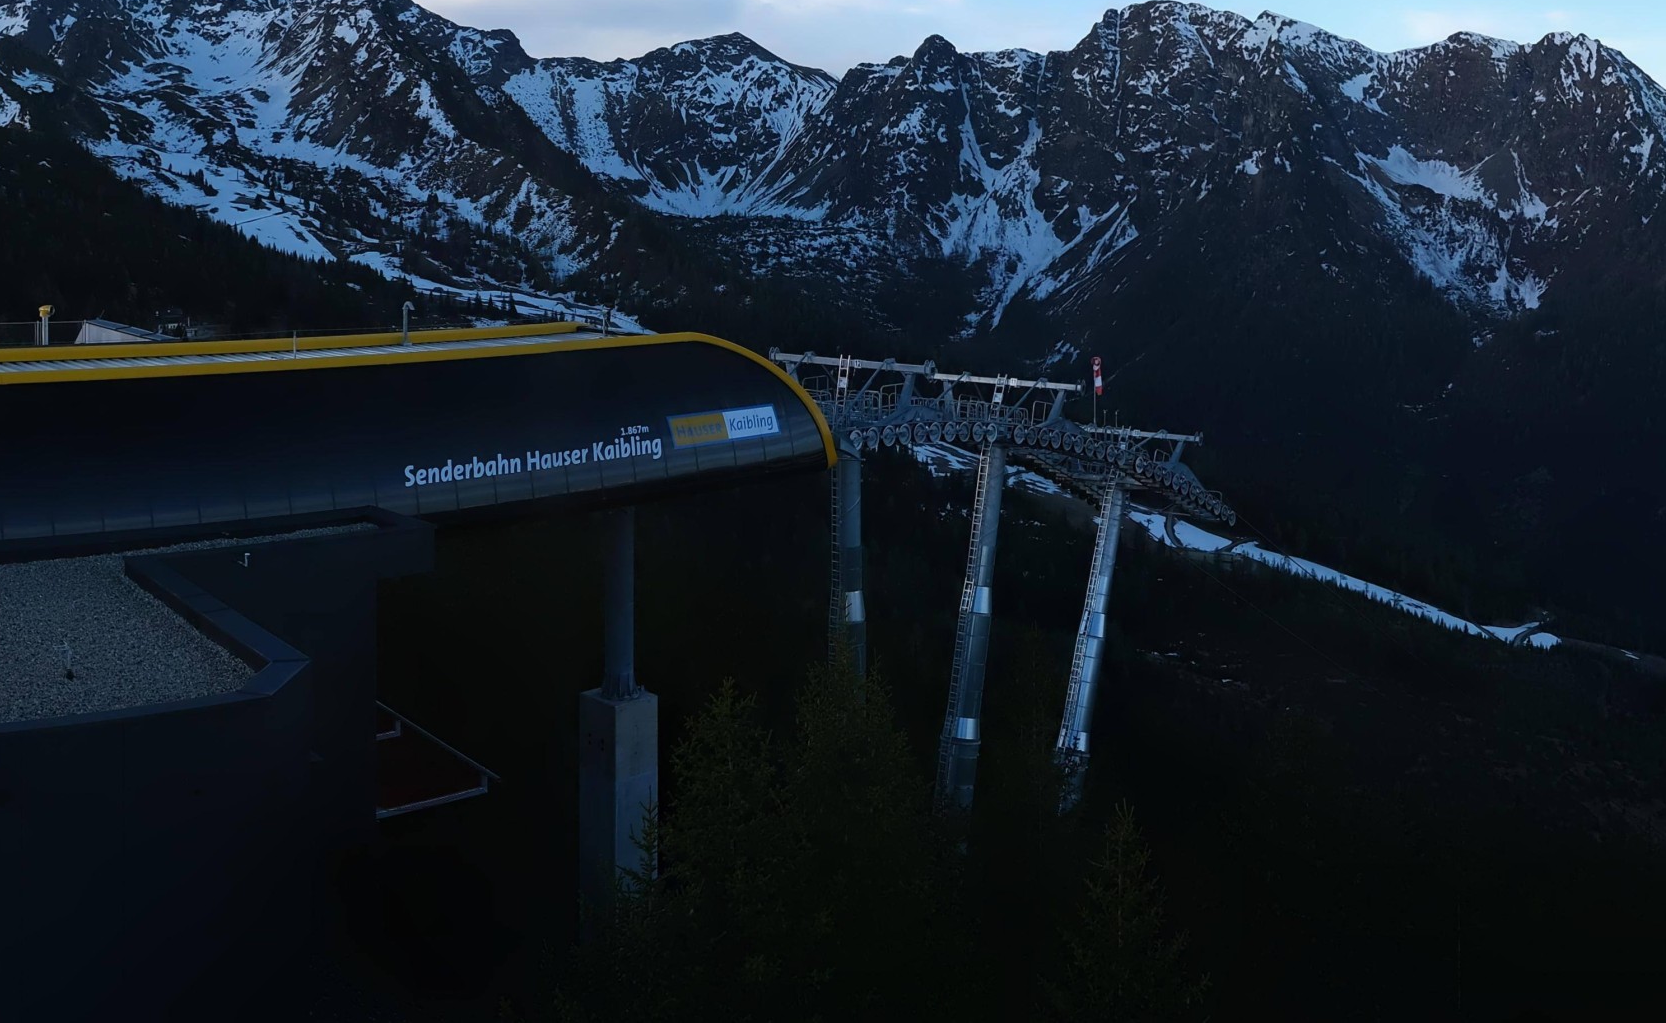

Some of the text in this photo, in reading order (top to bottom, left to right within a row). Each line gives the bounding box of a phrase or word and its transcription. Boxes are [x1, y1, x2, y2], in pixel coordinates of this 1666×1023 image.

[620, 424, 650, 437] 1.867m
[676, 412, 774, 438] HAUSER Kaibling
[404, 434, 663, 487] Senderbahn Hauser Kaibling
